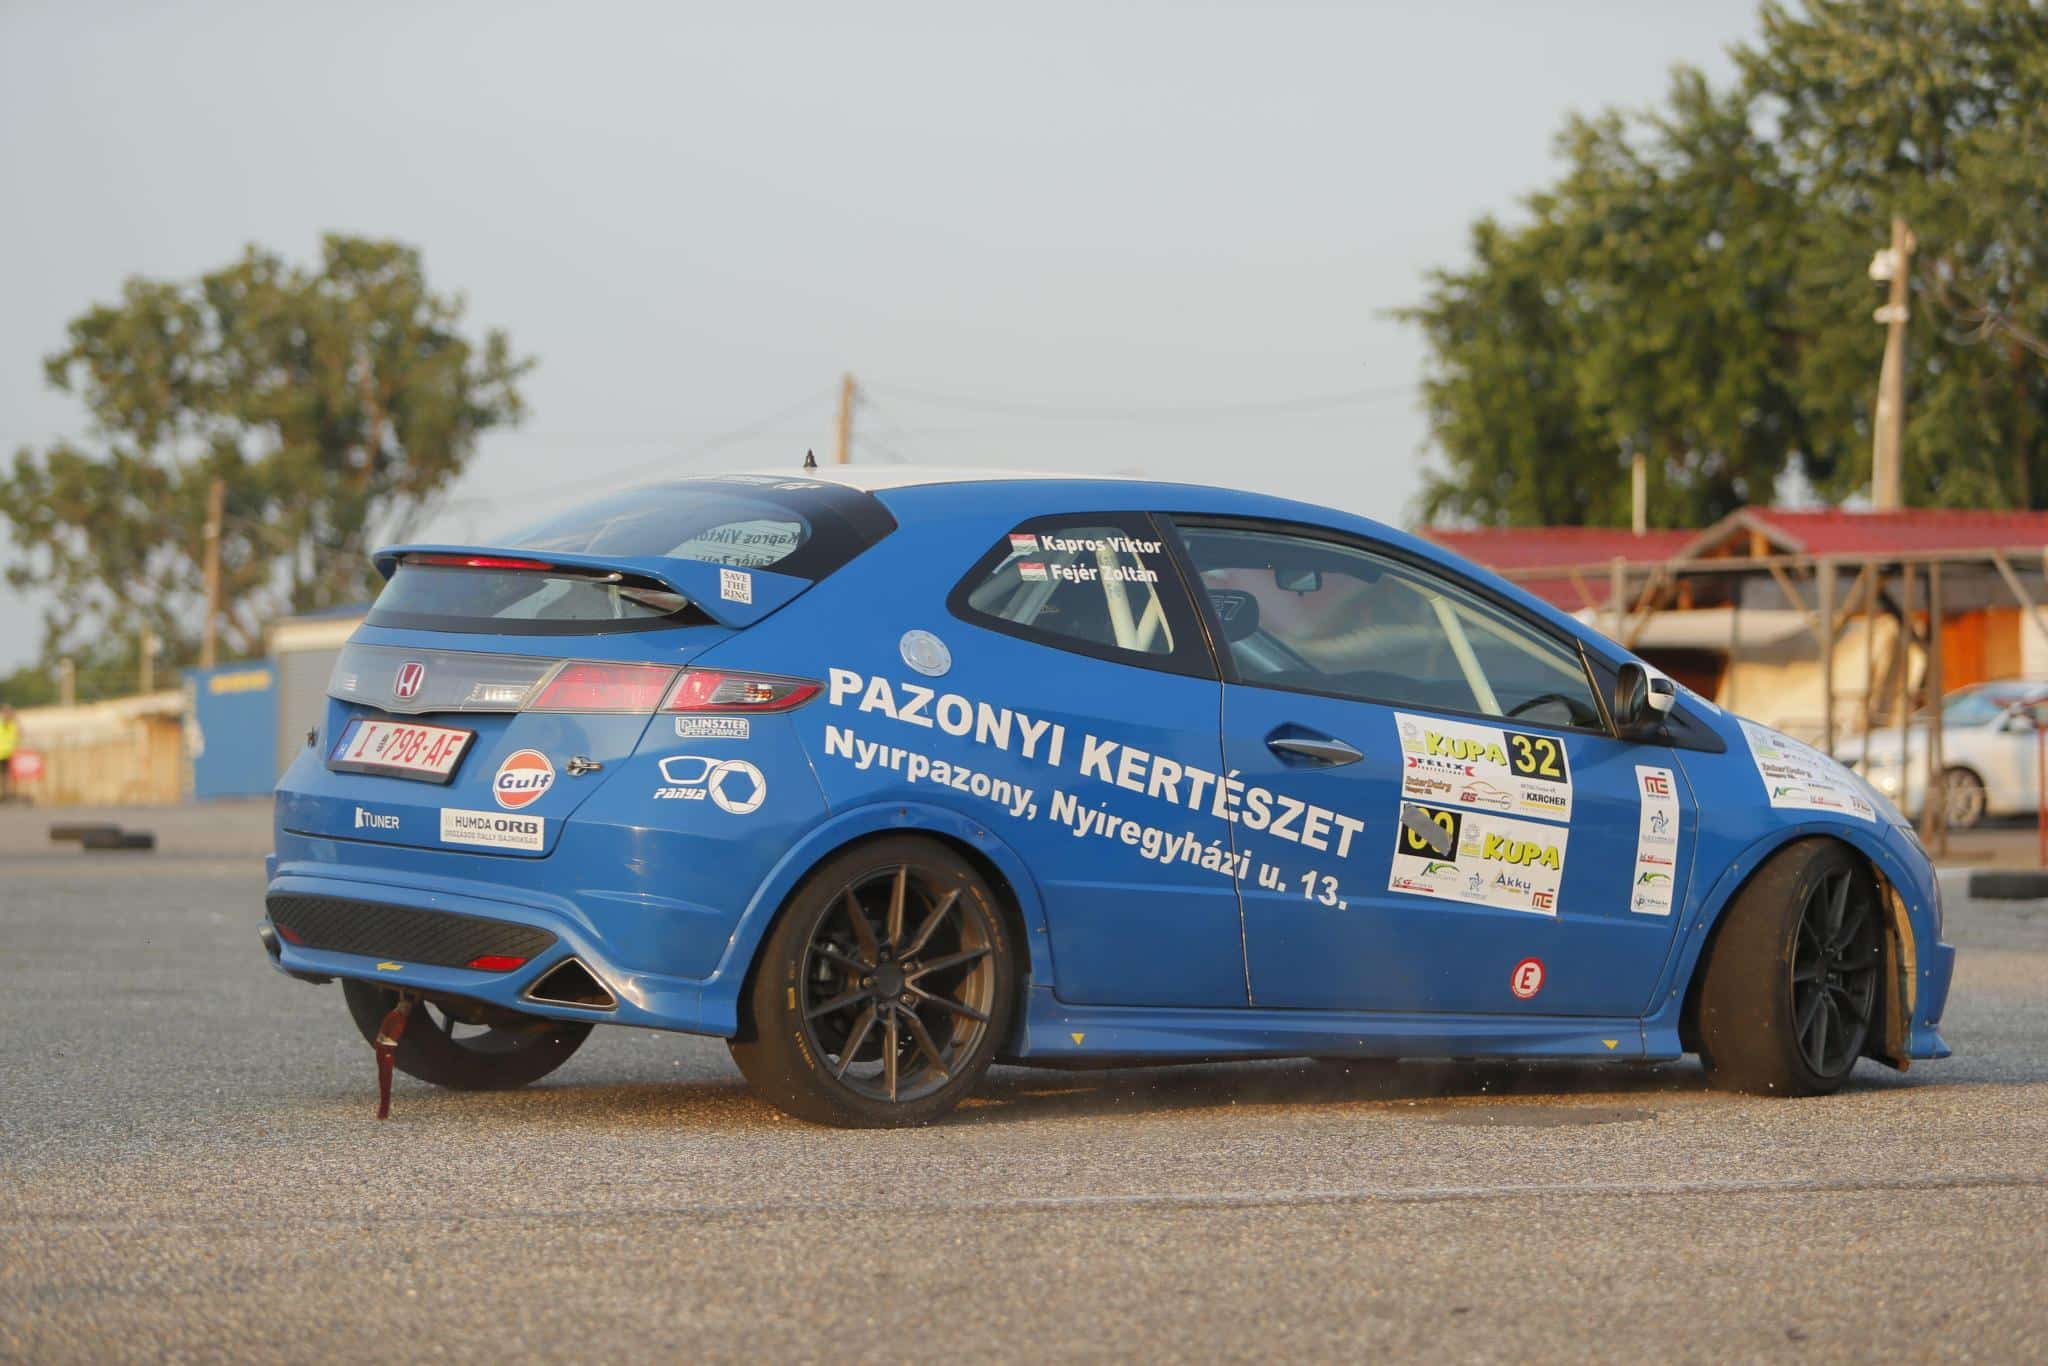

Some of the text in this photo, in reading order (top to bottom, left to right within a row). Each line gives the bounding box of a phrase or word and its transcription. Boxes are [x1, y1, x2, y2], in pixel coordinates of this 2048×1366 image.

[1041, 535, 1162, 554] Kapros Viktor
[723, 570, 748, 583] SAVE
[1050, 563, 1158, 583] Fejér Zoltán
[724, 588, 749, 600] RING
[727, 580, 747, 592] THE
[1424, 730, 1508, 767] KUPA
[1512, 735, 1561, 777] 32
[828, 667, 1065, 767] PAZONYI
[1079, 734, 1365, 859] KERTÉSZET
[498, 773, 552, 790] Gulf
[455, 815, 492, 830] HUMDA
[494, 818, 539, 835] ORB
[1049, 789, 1251, 881] Nyíregyházi
[1258, 863, 1287, 893] u.
[1300, 868, 1349, 910] 13.
[1483, 831, 1560, 871] KUPA
[1496, 871, 1532, 890] Akku
[1519, 967, 1535, 990] E
